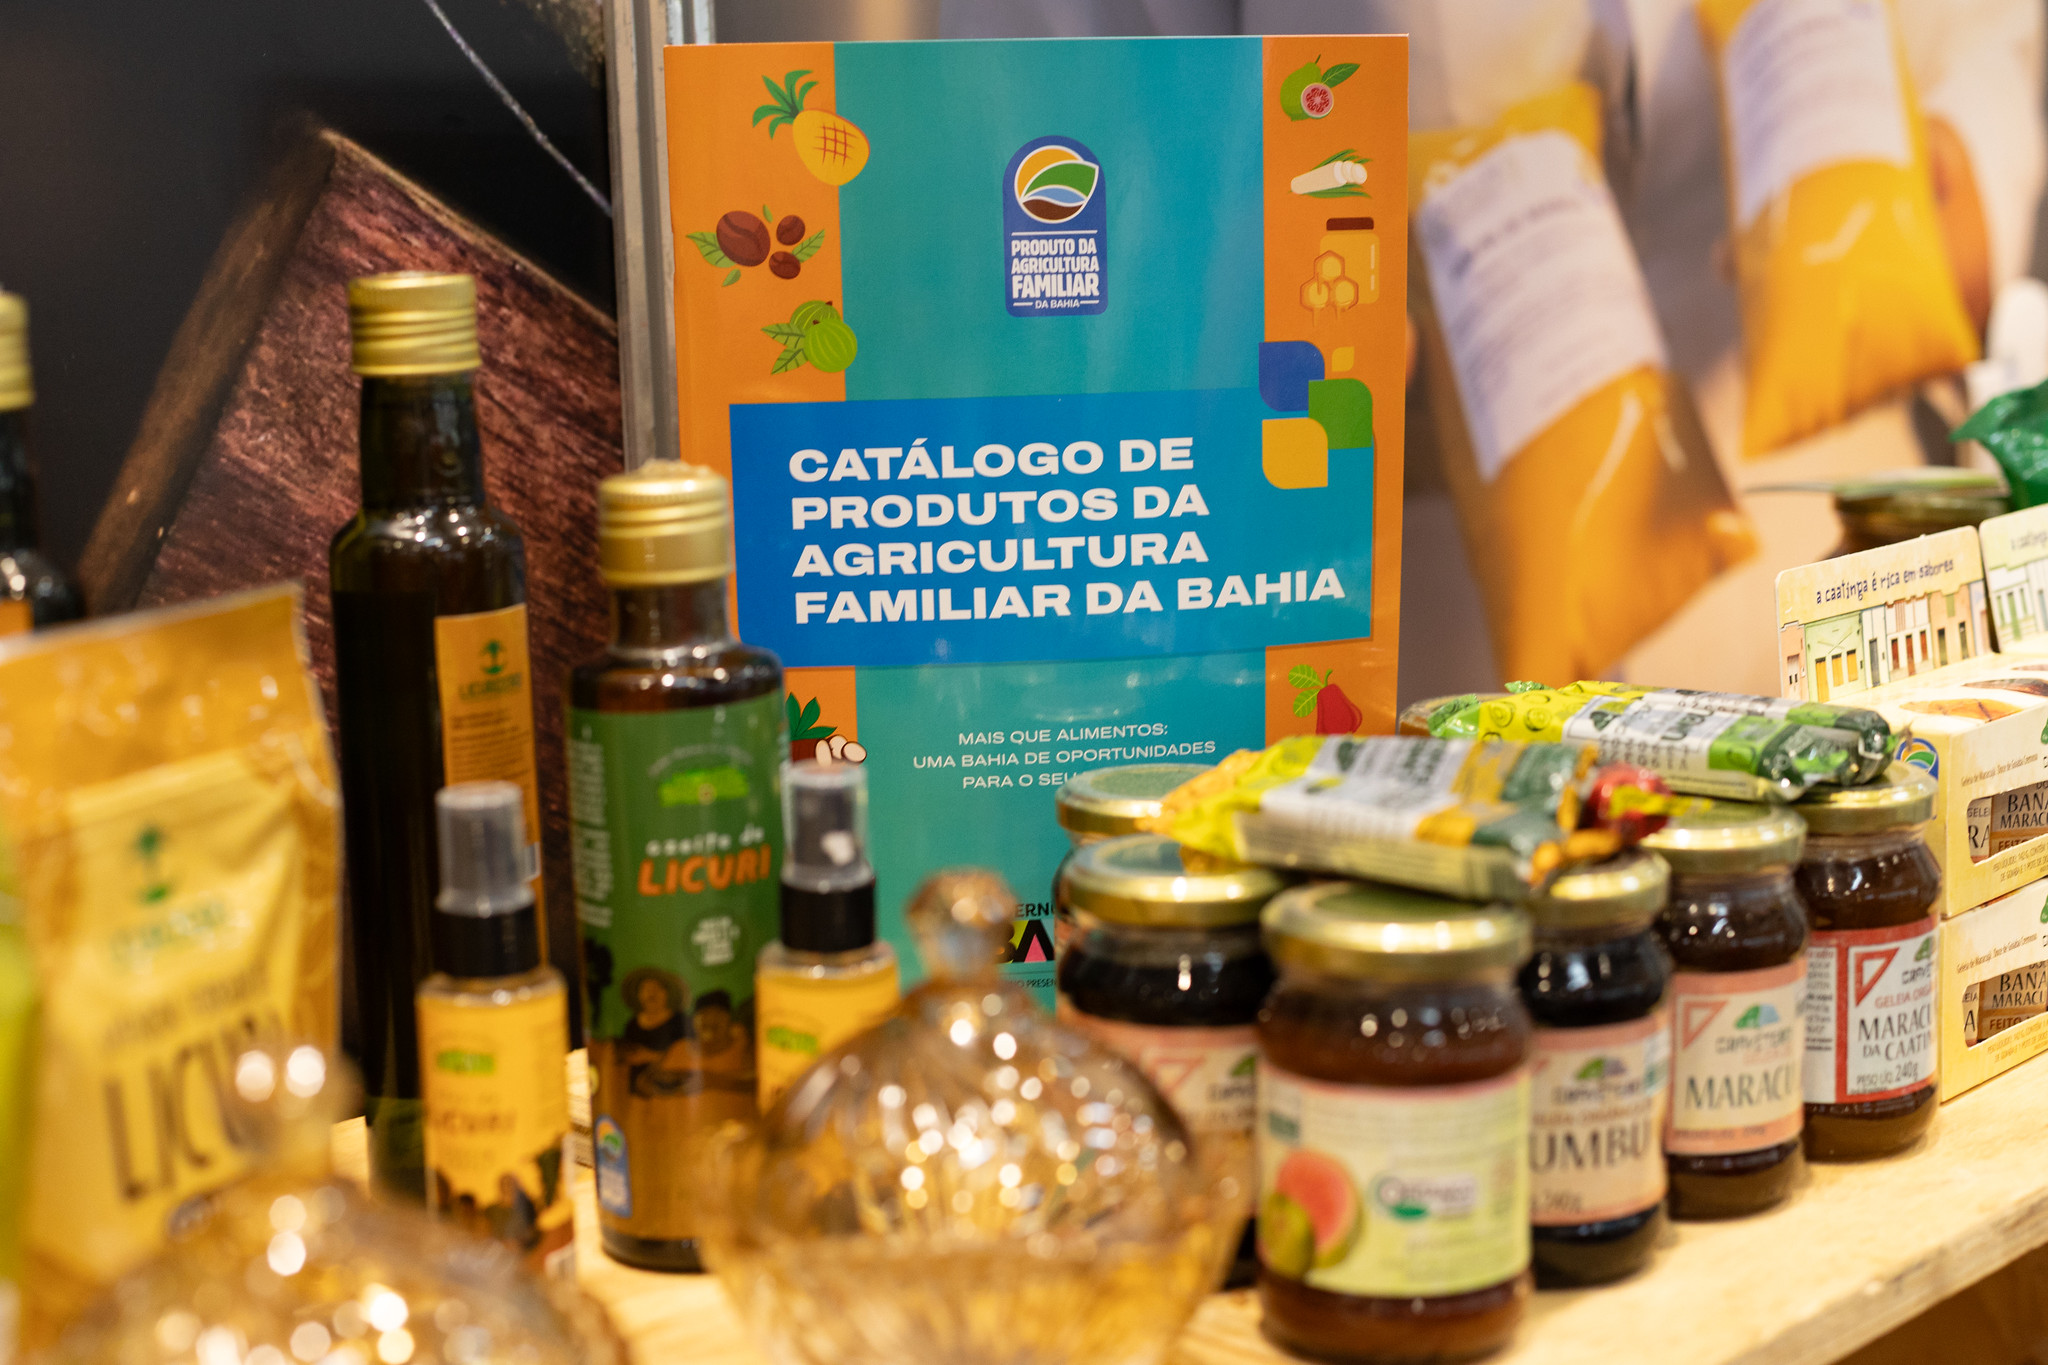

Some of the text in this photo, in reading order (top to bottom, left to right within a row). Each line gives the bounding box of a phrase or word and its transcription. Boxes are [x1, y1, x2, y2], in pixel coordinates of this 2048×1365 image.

[1011, 237, 1097, 256] PRODUTO DA
[1011, 255, 1100, 274] AGRICULTURA
[1012, 273, 1100, 298] FAMILIAR
[1035, 299, 1080, 309] DA BAHIA
[789, 437, 1194, 482] CATÁLOGO DE
[792, 484, 1210, 530] PRODUTOS DA
[792, 531, 1209, 577] AGRICULTURA
[795, 568, 1346, 624] FAMILIAR DA BAHIA
[1816, 590, 1822, 604] a
[1825, 577, 1868, 601] caatinga
[1872, 571, 1877, 591] é
[1903, 570, 1916, 582] em
[959, 723, 1168, 745] MAIS QUE ALIMENTOS:
[913, 741, 1216, 769] UMA BAHIA DE OPORTUNIDADES
[963, 774, 1013, 789] PARA
[1019, 774, 1033, 787] O
[637, 844, 771, 896] LICURI
[1863, 1044, 1881, 1058] DA
[1529, 1119, 1651, 1173] UMBU
